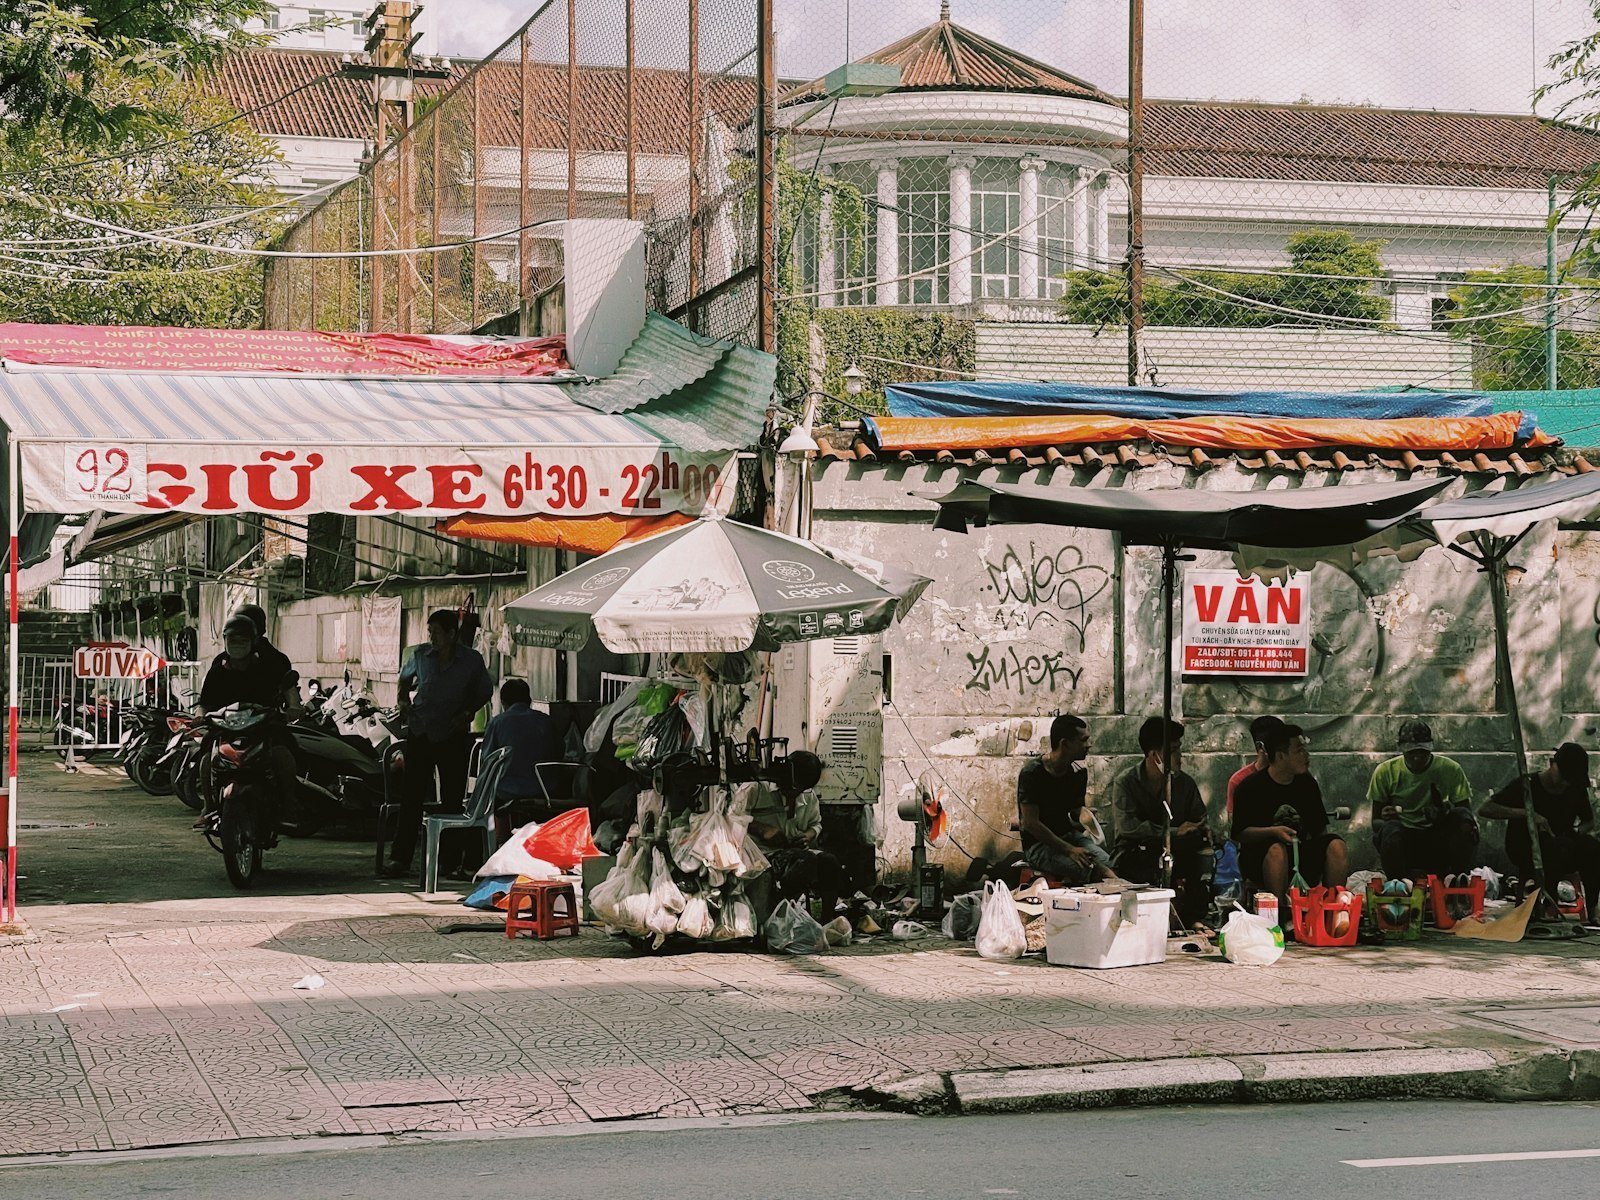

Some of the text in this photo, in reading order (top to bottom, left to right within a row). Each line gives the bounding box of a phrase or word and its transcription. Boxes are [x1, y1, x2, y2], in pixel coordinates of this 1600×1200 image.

[104, 330, 156, 339] NHIỆT
[160, 331, 194, 339] LIỆT
[76, 448, 133, 493] 92
[135, 450, 324, 510] GIỮ
[349, 464, 486, 511] XE
[503, 452, 588, 509] 6h30
[776, 582, 854, 599] Legend
[539, 593, 598, 607] Legend
[1192, 577, 1302, 625] VĂN
[1201, 627, 1226, 636] CHUYÊN
[1226, 626, 1239, 635] SỬA
[1202, 636, 1219, 644] XÁCH
[1190, 658, 1233, 668] FACEBOOK:
